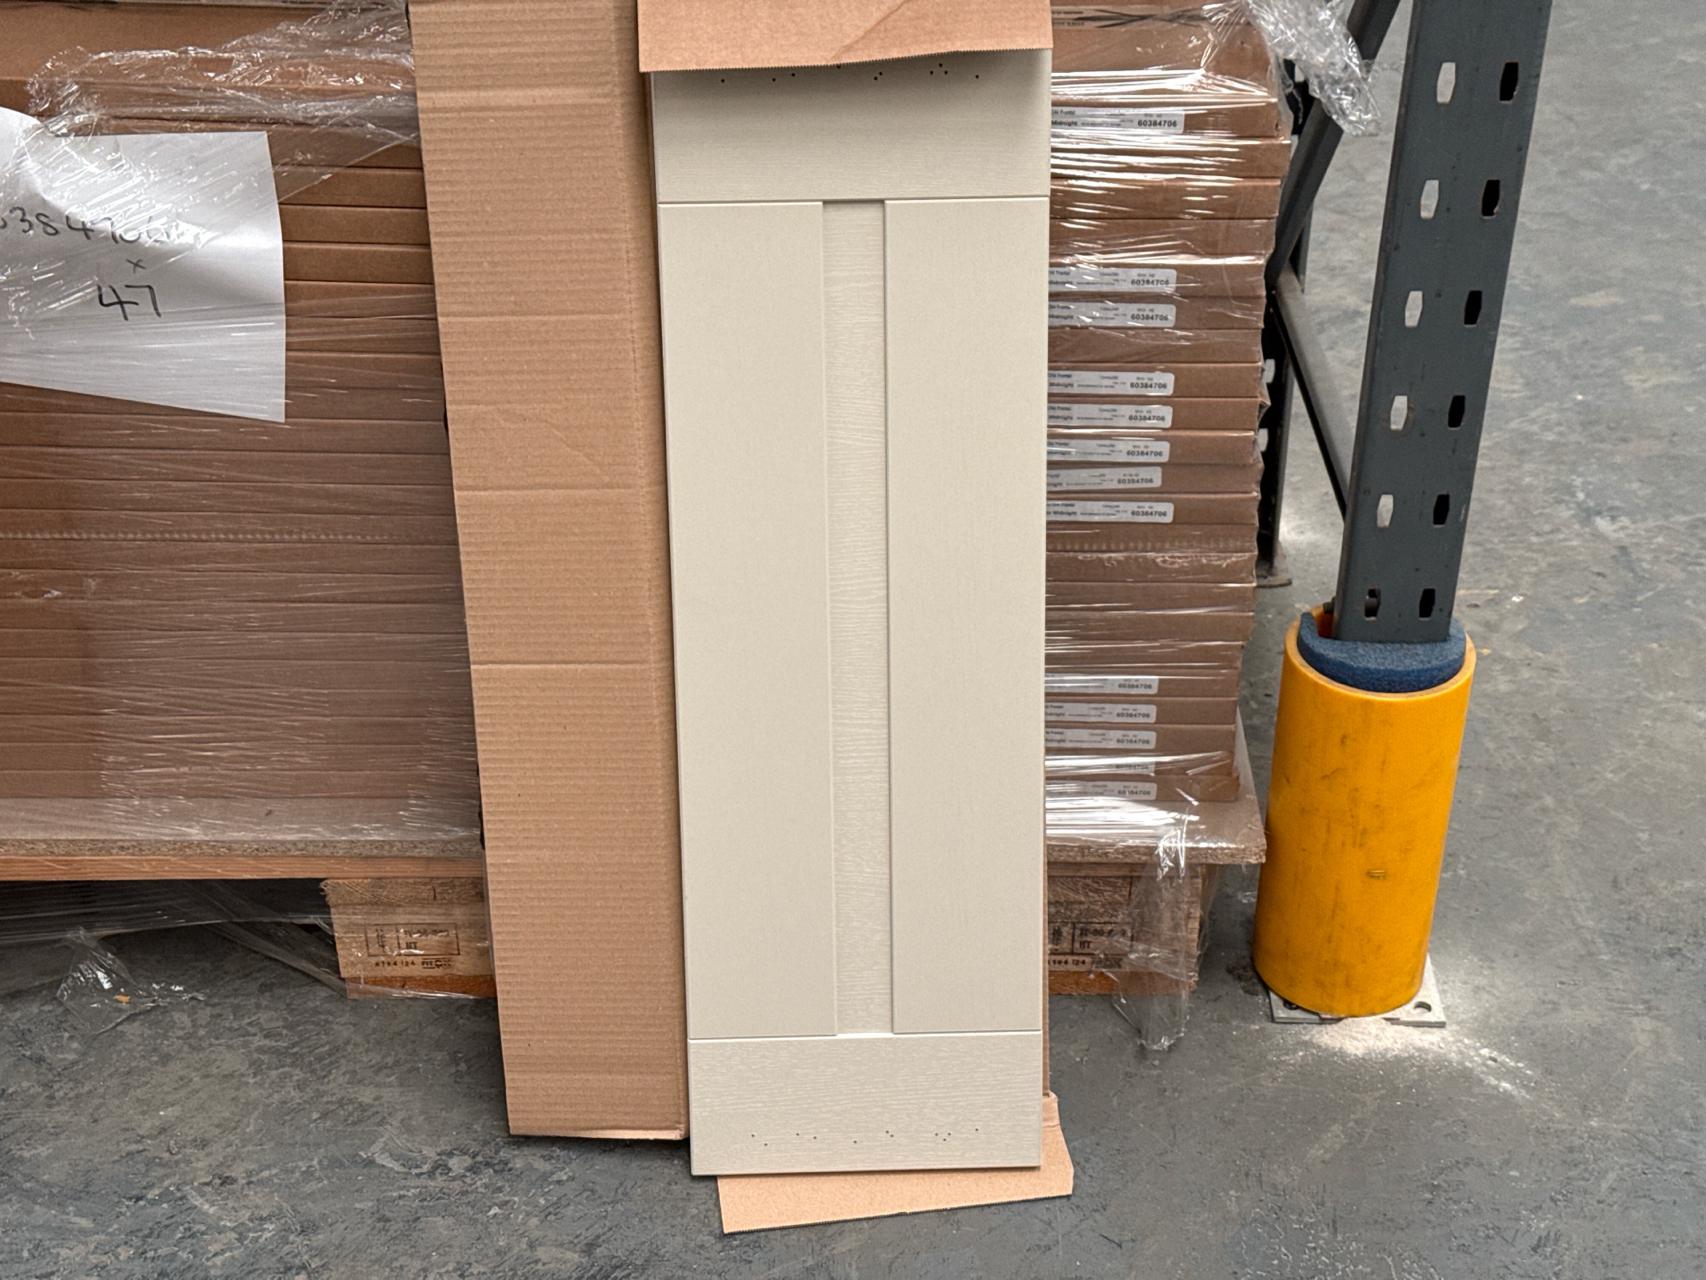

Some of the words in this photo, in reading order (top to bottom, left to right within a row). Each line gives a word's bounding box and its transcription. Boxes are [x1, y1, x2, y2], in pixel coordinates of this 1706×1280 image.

[1137, 119, 1178, 128] 60384706
[1130, 278, 1170, 286] 60384706
[97, 284, 162, 321] 47
[1130, 313, 1168, 321] 60384706
[1129, 382, 1167, 390] 60384706
[1128, 414, 1166, 422] 60384706
[1126, 449, 1163, 457] 60384706
[1130, 509, 1168, 518] 60384706
